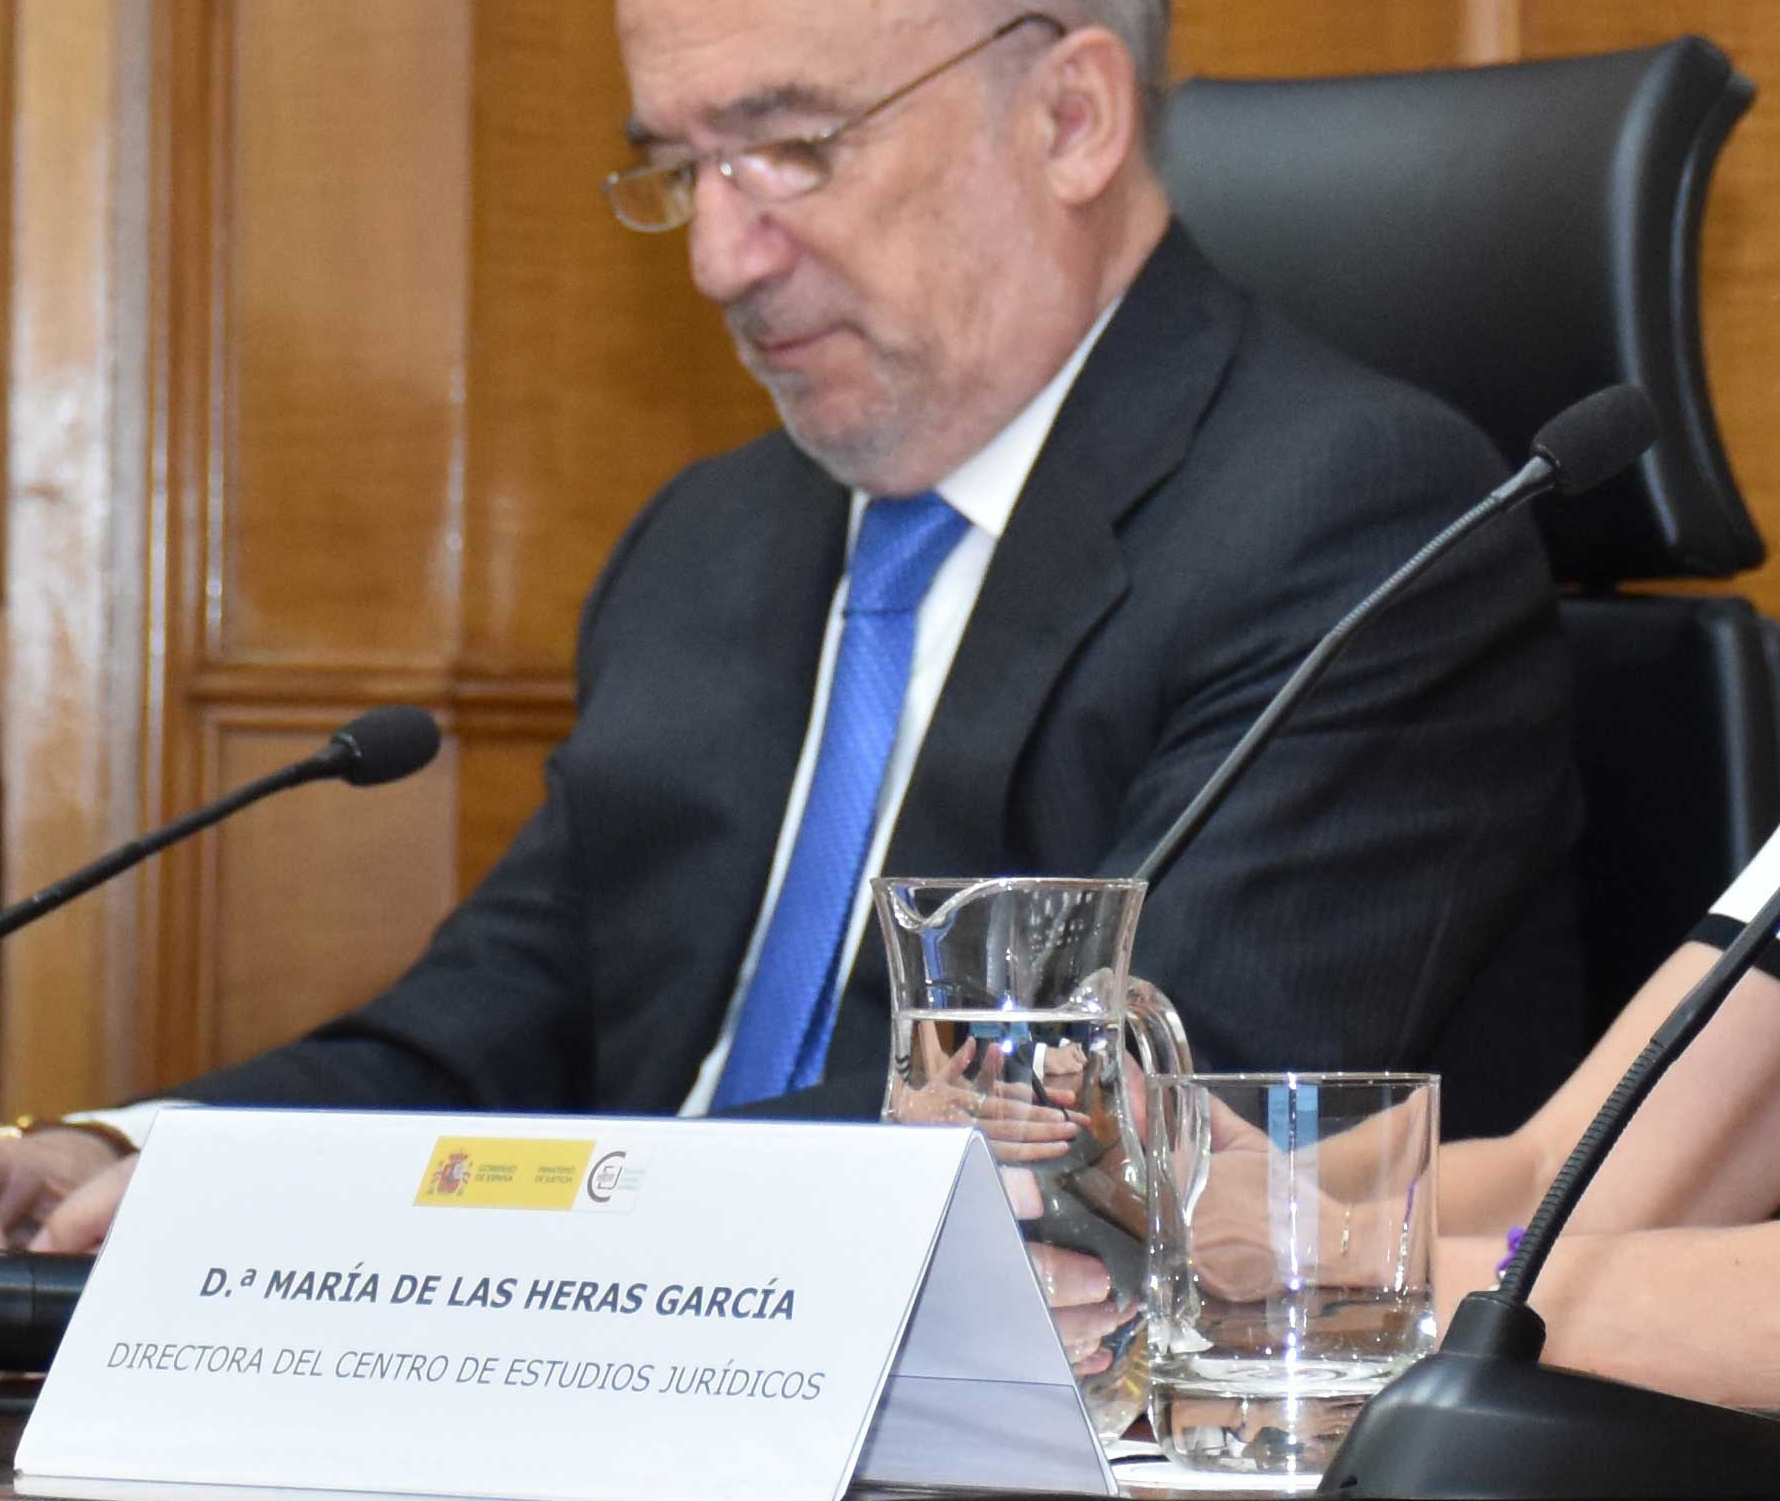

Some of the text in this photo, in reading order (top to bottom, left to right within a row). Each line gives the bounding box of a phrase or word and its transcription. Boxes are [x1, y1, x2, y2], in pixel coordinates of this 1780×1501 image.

[263, 1261, 380, 1303] MARÍA
[389, 1274, 442, 1305] DE
[447, 1276, 517, 1309] LAS
[524, 1279, 648, 1315] HERAS
[654, 1277, 796, 1321] GARCÍA
[107, 1342, 826, 1401] DIRECTORA DEL CENTRO DE ESTUDIOS JURÍDICOS
